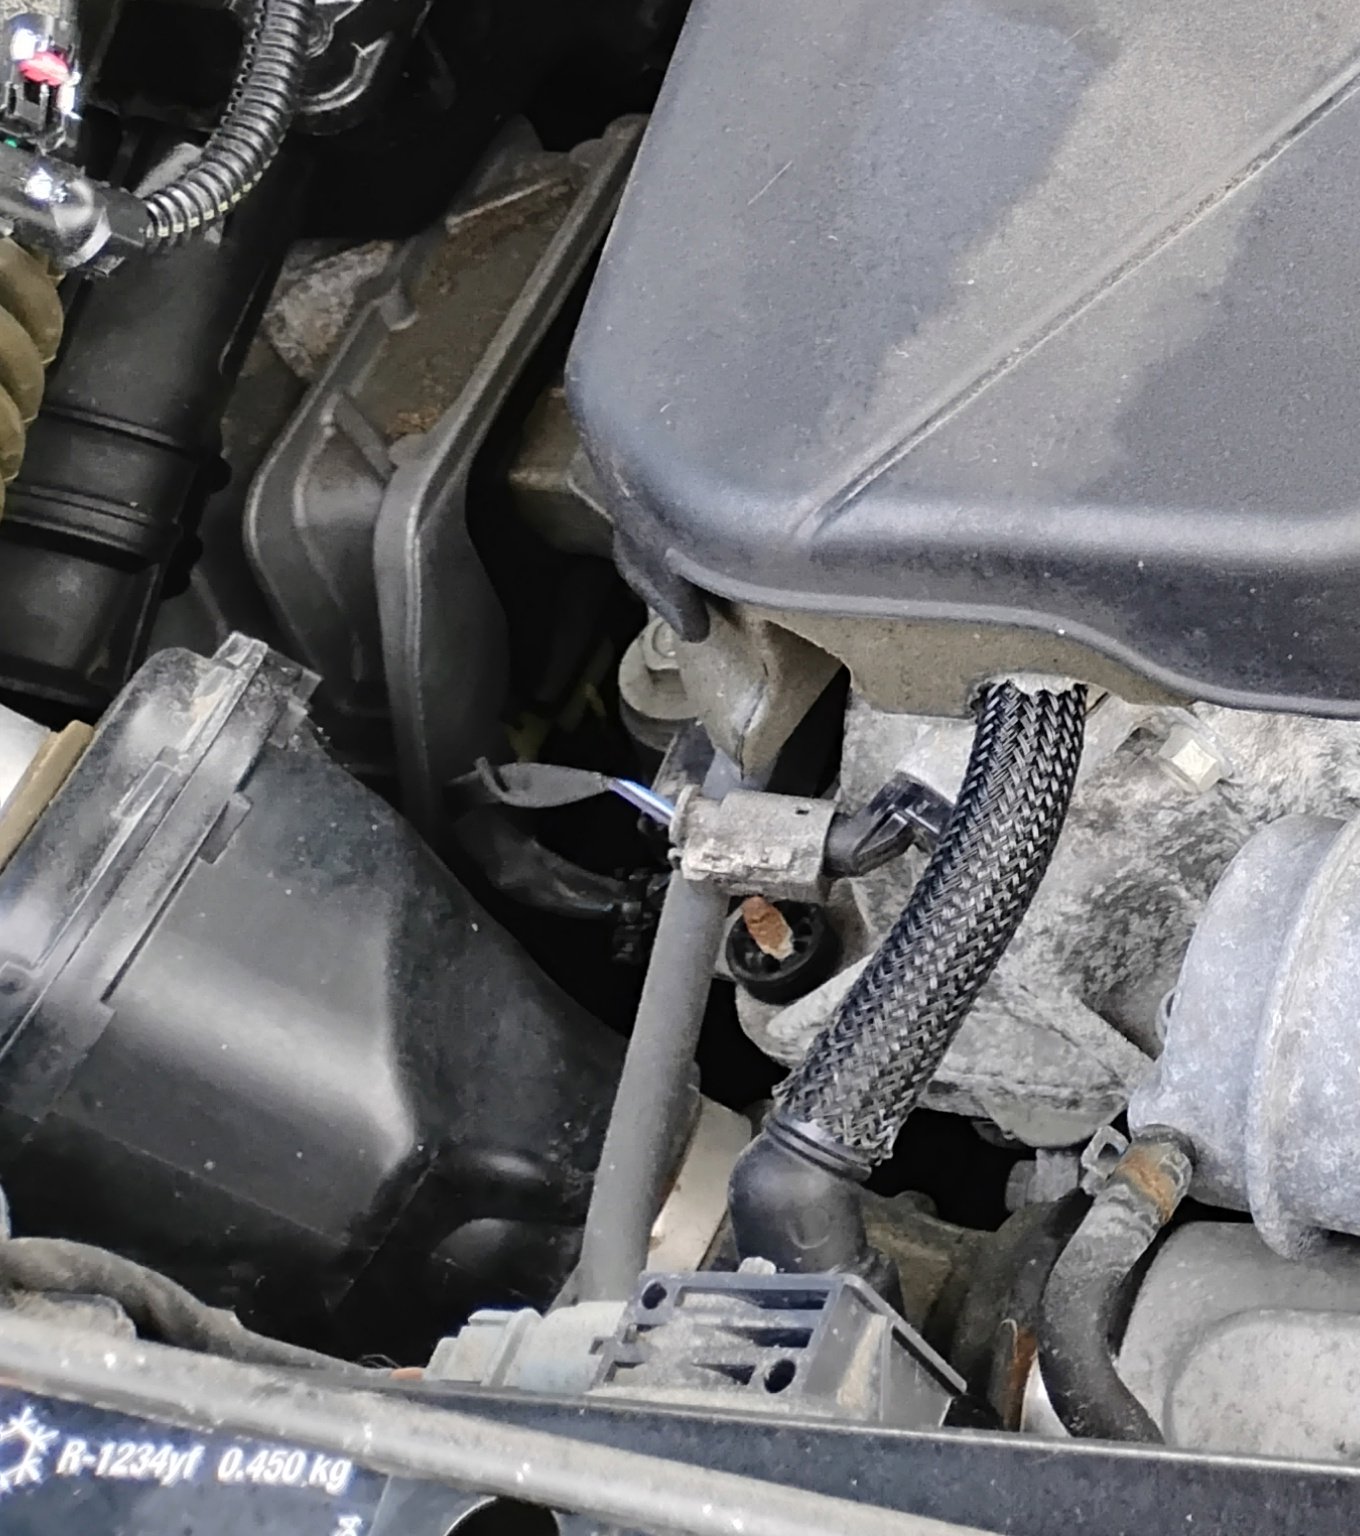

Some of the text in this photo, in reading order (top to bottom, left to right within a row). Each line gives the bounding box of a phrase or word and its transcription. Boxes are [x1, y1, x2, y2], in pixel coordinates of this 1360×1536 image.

[56, 1440, 353, 1496] R-1234yf 0.450 kg
